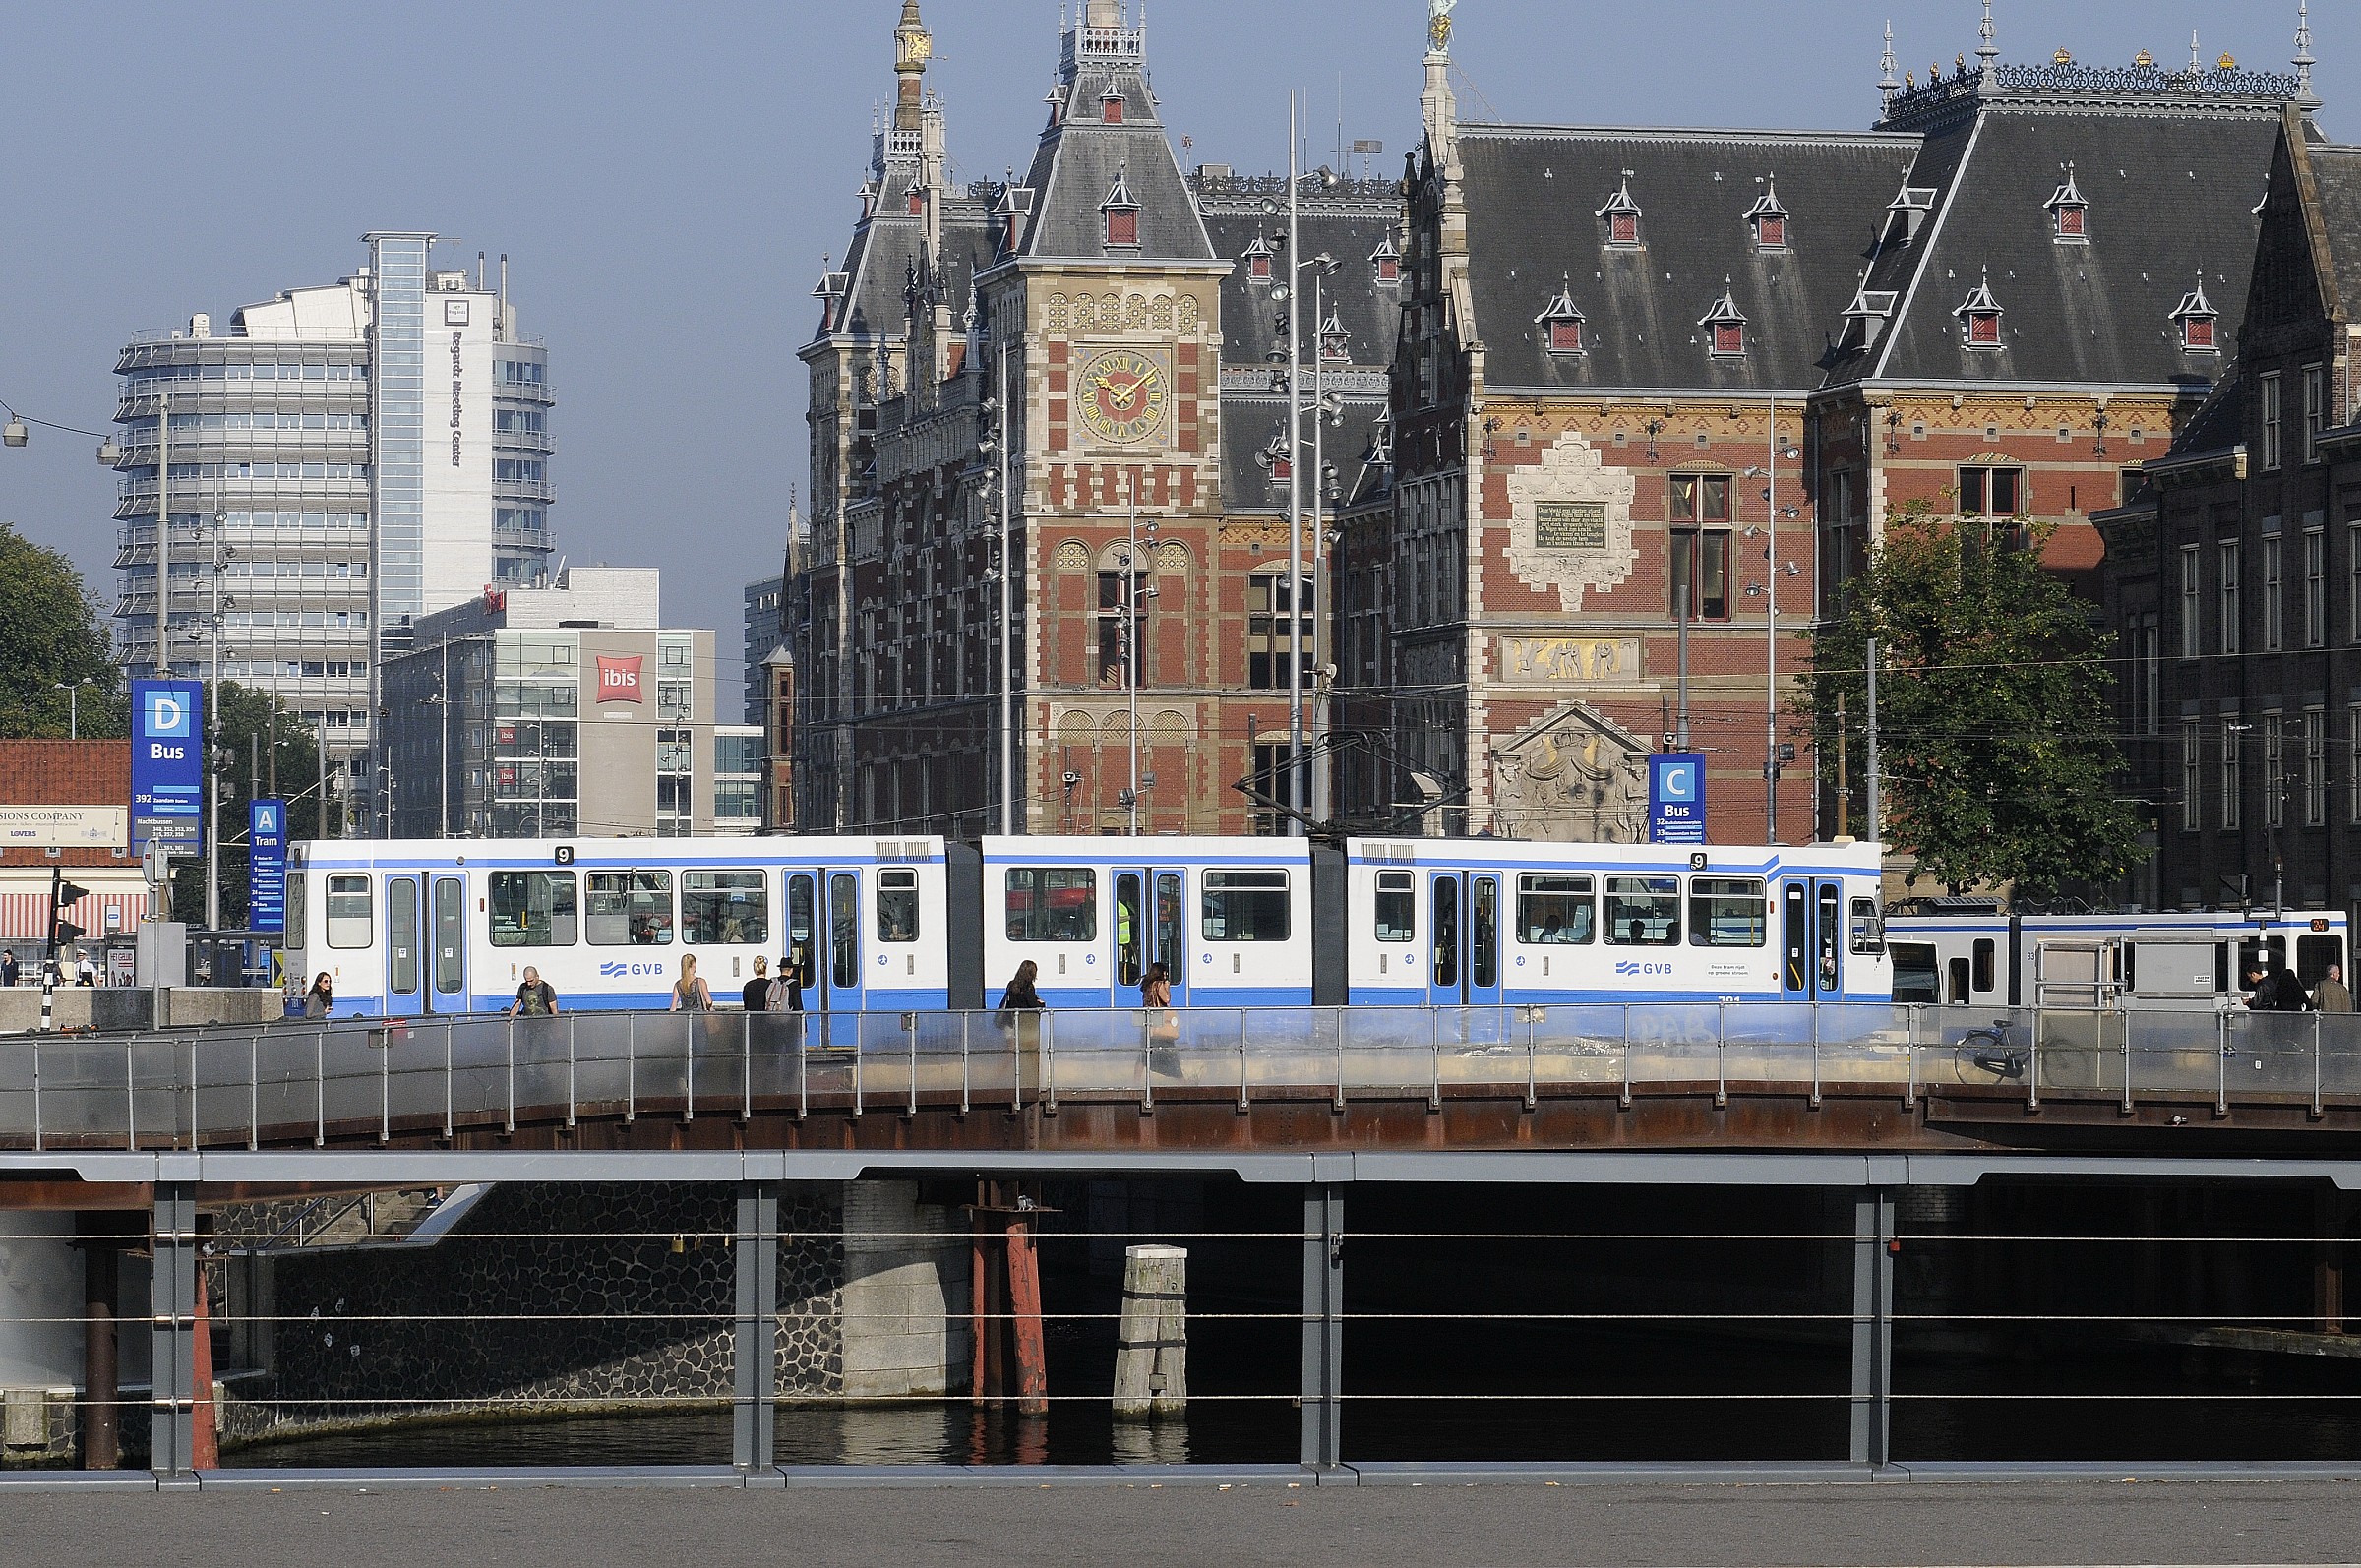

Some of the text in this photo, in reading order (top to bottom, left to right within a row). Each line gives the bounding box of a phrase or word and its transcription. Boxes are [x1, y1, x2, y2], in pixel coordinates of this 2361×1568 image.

[1098, 361, 1113, 374] XI
[1115, 357, 1129, 369] XII
[450, 381, 462, 428] Meeting
[452, 431, 462, 467] Center
[603, 669, 636, 686] ibis
[155, 699, 180, 729] D
[151, 743, 184, 759] Bus
[1667, 769, 1685, 795] C
[135, 794, 152, 803] 392
[31, 812, 84, 820] COMPANY
[1665, 804, 1689, 817] Bus
[258, 810, 273, 828] A
[255, 837, 278, 846] Tram
[558, 848, 569, 862] 9
[1695, 855, 1703, 868] 9
[631, 964, 663, 975] GVB
[1644, 963, 1672, 974] GVB
